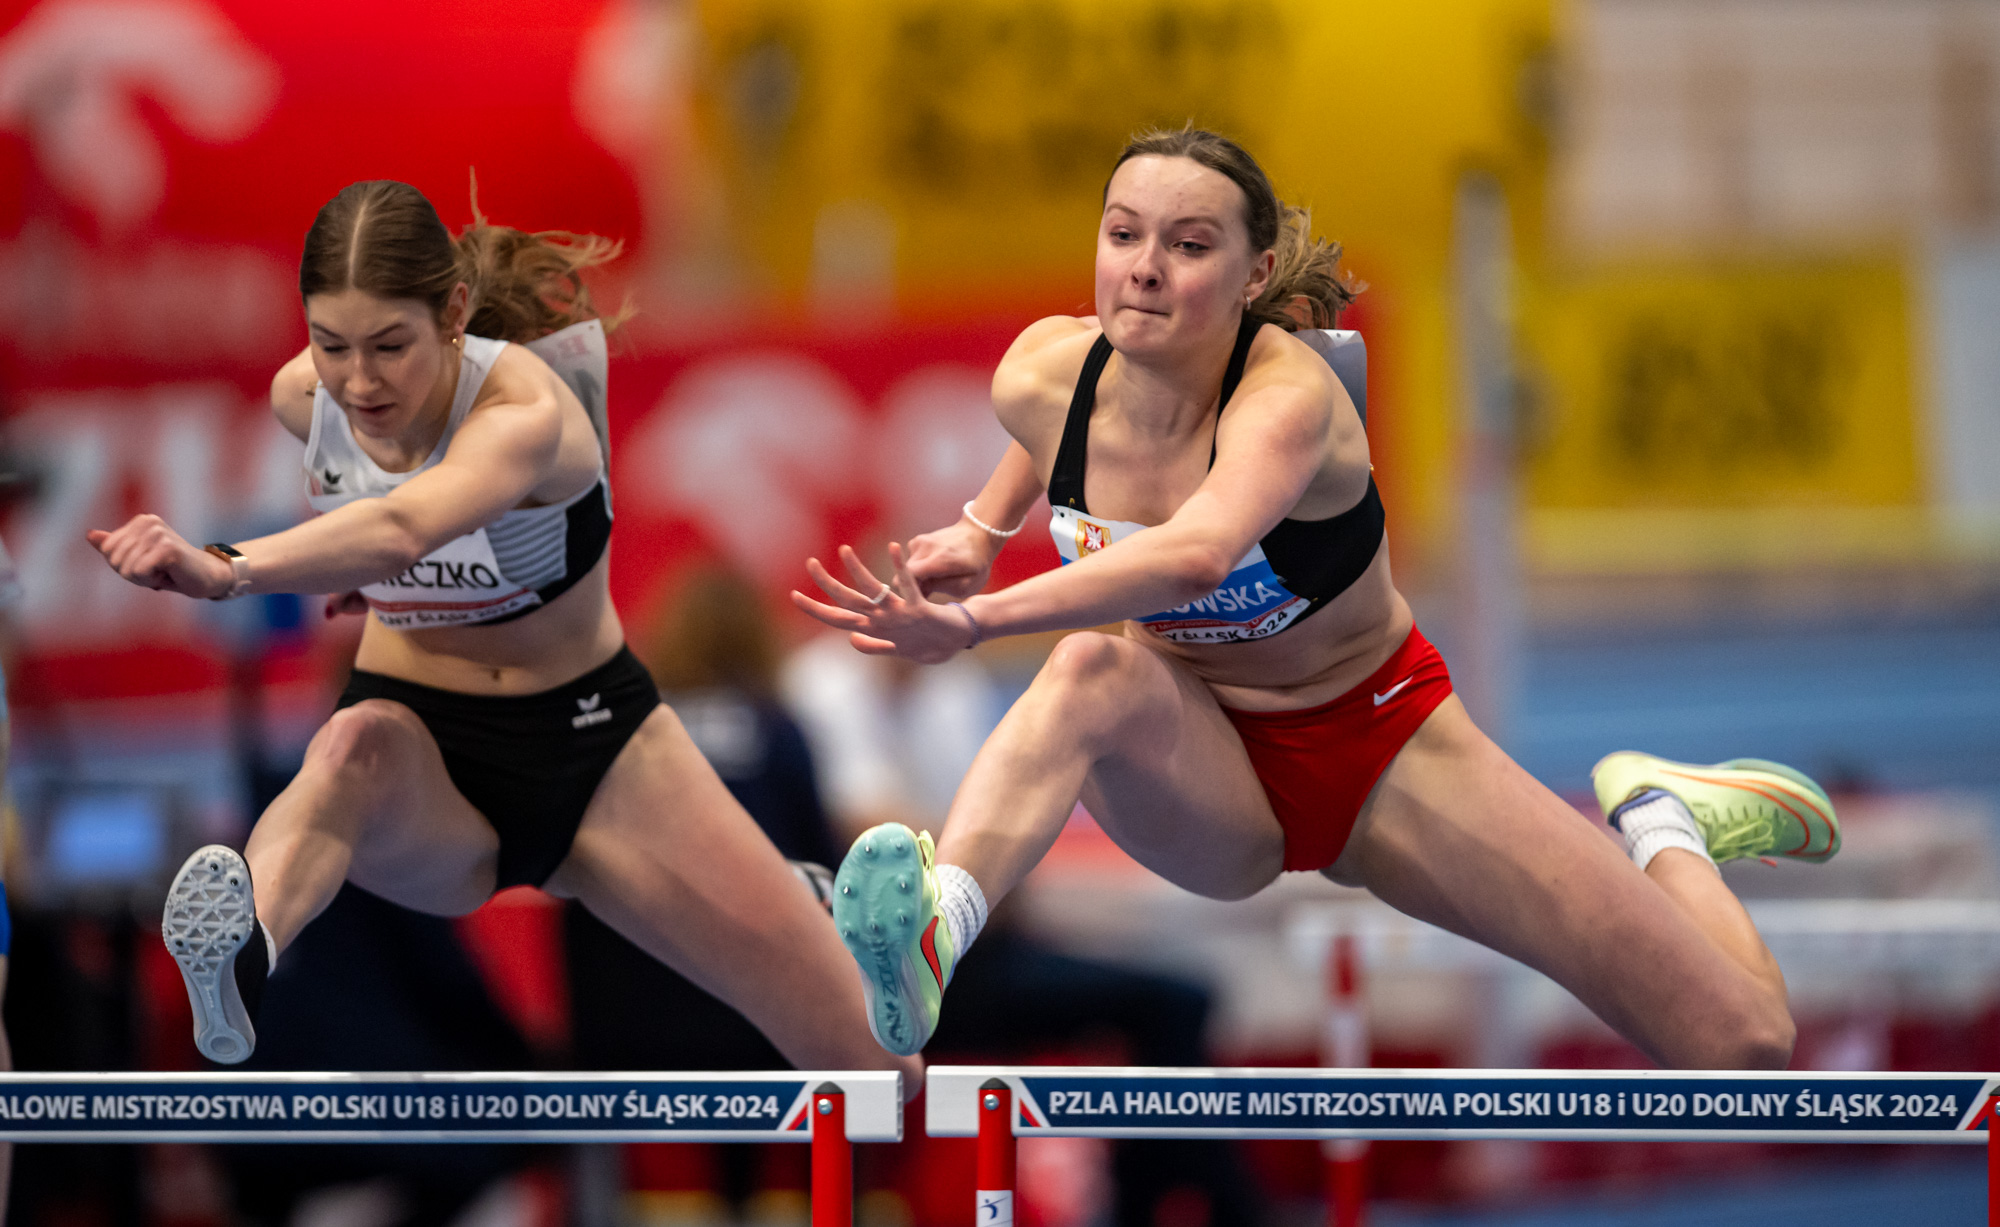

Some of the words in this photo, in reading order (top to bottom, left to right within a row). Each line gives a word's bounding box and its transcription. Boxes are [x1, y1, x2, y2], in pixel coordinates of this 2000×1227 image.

[380, 560, 499, 588] ECZKO
[1165, 581, 1281, 614] WSKA
[1247, 610, 1289, 638] 2024
[92, 1095, 287, 1119] MISTRZOSTWA
[292, 1095, 387, 1119] POLSKI
[393, 1095, 446, 1119] U18
[452, 1094, 459, 1118] i
[466, 1095, 518, 1118] U20
[524, 1094, 618, 1118] DOLNY
[623, 1090, 709, 1124] ŚLĄSK
[713, 1095, 779, 1119] 2024
[1049, 1091, 1119, 1115] PZLA
[1124, 1092, 1242, 1115] HALOWE
[1247, 1092, 1448, 1116] MISTRZOSTWA
[1453, 1092, 1551, 1116] POLSKI
[1557, 1093, 1612, 1116] U18
[1617, 1092, 1626, 1116] i
[1632, 1093, 1687, 1117] U20
[1692, 1094, 1790, 1117] DOLNY
[1795, 1089, 1885, 1124] ŚLĄSK
[1889, 1094, 1958, 1117] 2024
